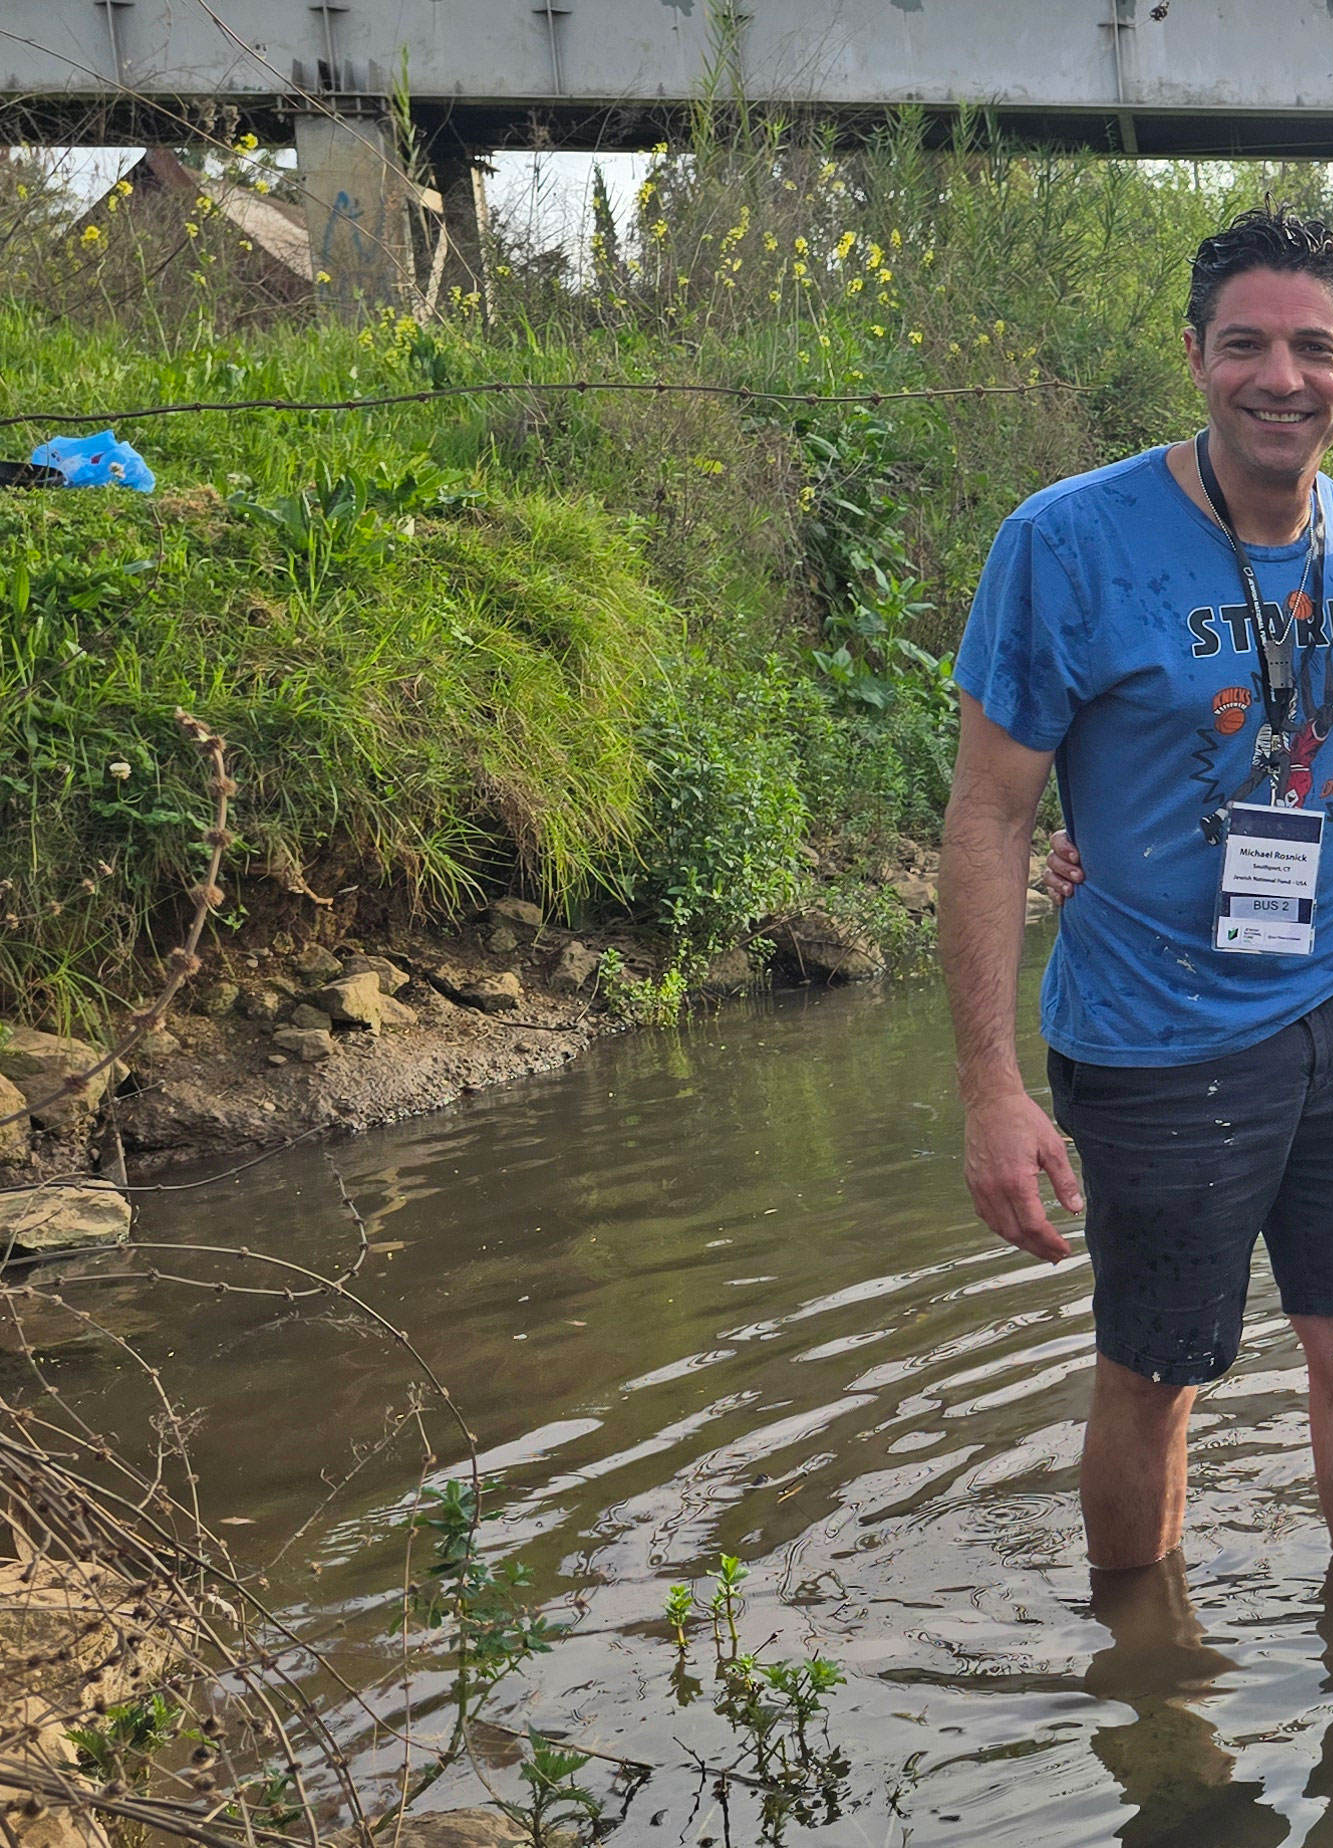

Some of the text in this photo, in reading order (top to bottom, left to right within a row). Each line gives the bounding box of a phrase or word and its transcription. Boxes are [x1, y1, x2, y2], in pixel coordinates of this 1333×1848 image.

[1240, 848, 1308, 862] Michael Rosnick
[1253, 900, 1289, 911] BUS 2
